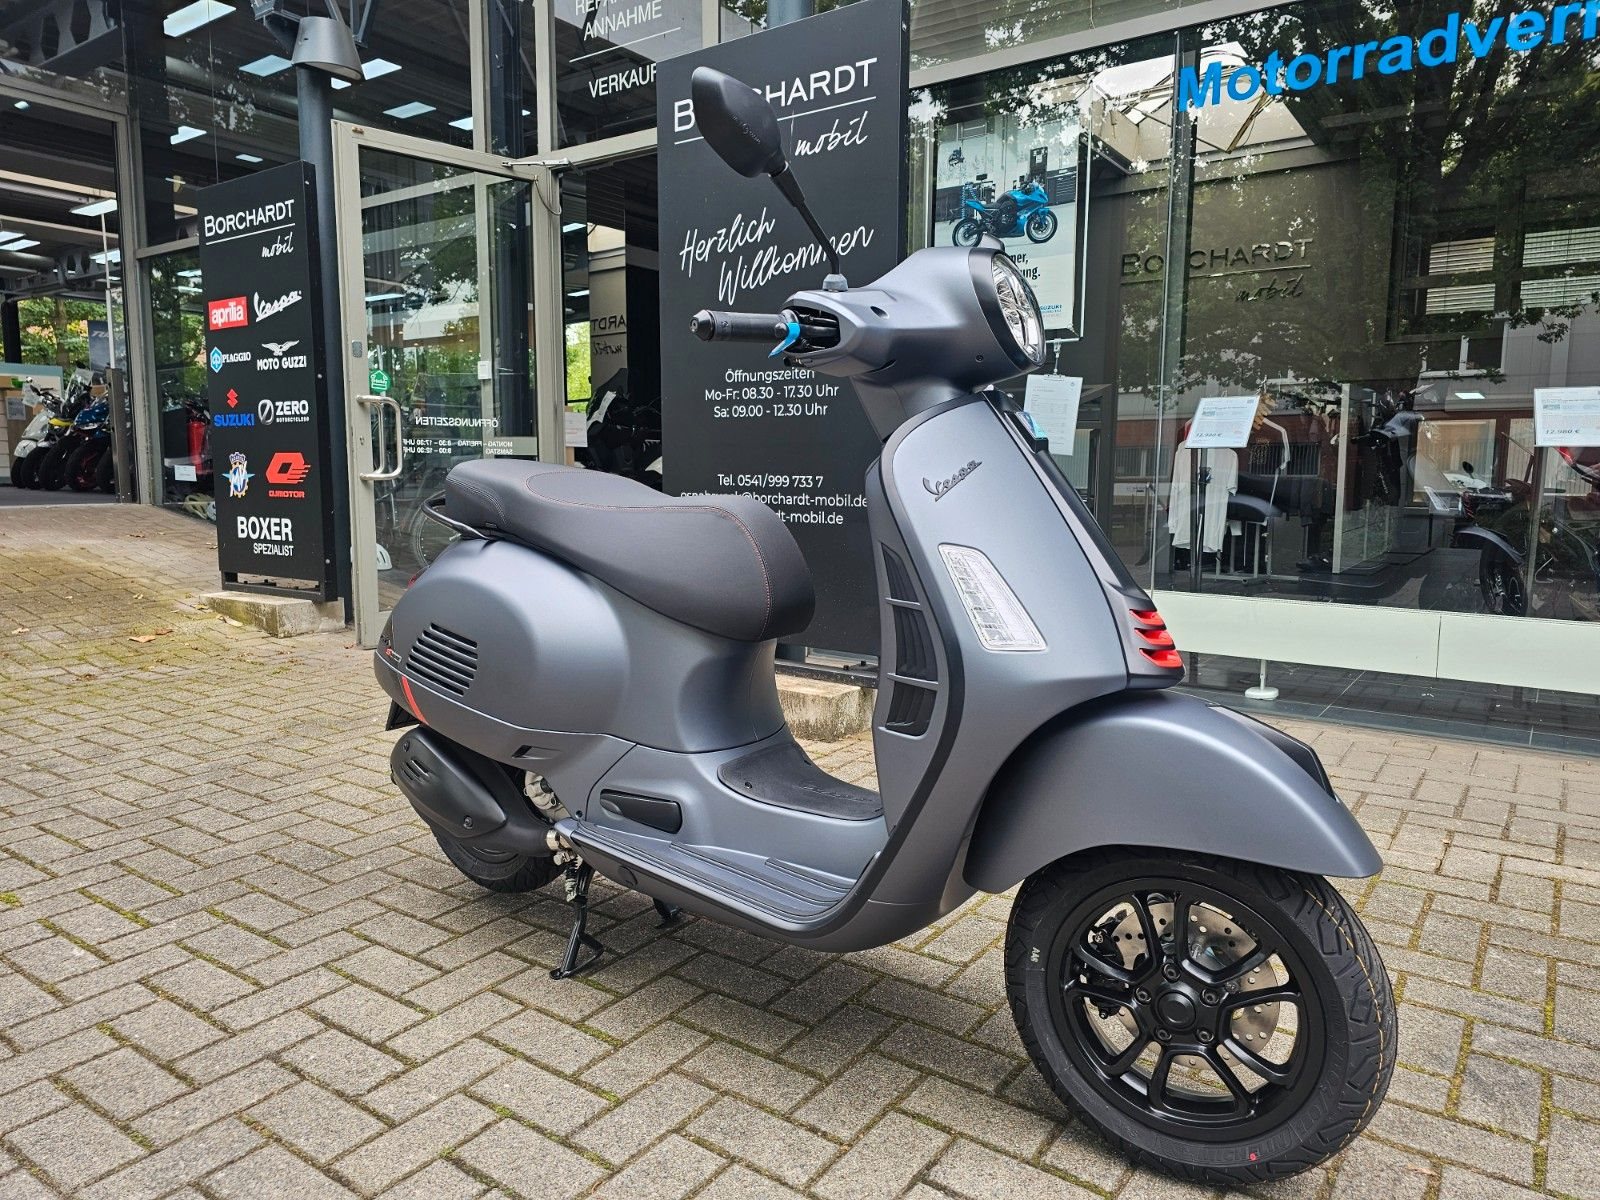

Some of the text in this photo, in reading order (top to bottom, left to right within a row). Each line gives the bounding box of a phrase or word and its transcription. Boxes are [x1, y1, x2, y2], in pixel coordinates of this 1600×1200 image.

[583, 0, 663, 41] ANNAHME
[588, 62, 657, 99] VERKAUF
[674, 57, 877, 132] BHARDT
[794, 110, 869, 156] mobil
[204, 199, 295, 237] BORCHARDT
[261, 231, 294, 258] mobil
[679, 207, 775, 278] Herzlich
[1121, 237, 1314, 277] BOCHARDT
[1235, 273, 1304, 302] mobil
[211, 302, 244, 327] aprilia
[253, 290, 302, 323] Vespa
[222, 351, 251, 363] PIAGGIO
[256, 355, 307, 371] MOTO GUZZI
[725, 367, 815, 384] Öffnungszeiten
[741, 386, 774, 400] 08.30
[783, 385, 813, 399] 17.30
[815, 383, 840, 397] Uhr
[213, 413, 255, 427] SUZUKI
[275, 400, 309, 415] ZERO
[713, 405, 730, 418] Sa:
[731, 404, 764, 417] 09.00
[773, 403, 802, 417] 12.30
[805, 402, 829, 416] Uhr
[717, 472, 824, 488] Tel. 0541/999 733 7
[922, 460, 982, 502] Vespa
[237, 516, 293, 541] BOXER
[253, 542, 294, 557] SPEZIALIST
